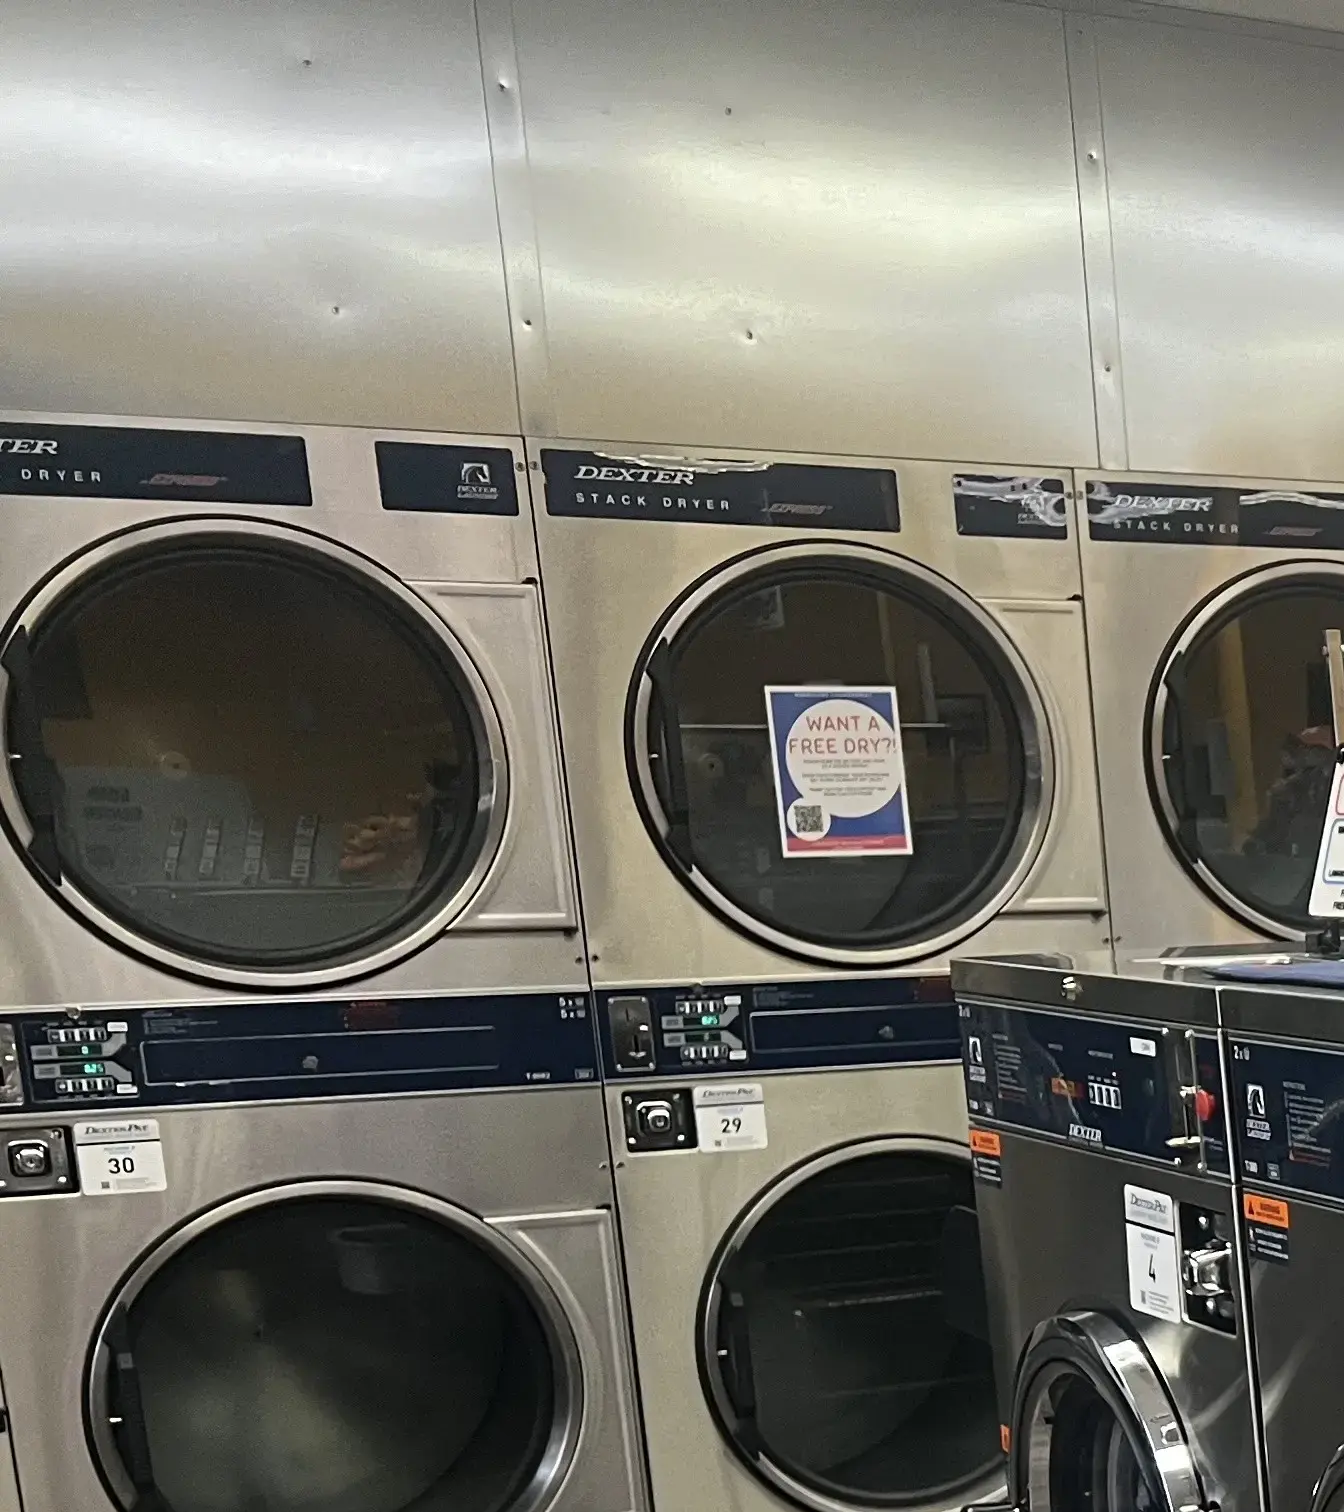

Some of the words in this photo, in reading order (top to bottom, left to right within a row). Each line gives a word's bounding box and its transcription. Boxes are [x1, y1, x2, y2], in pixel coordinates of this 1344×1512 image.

[22, 469, 100, 482] DRYER
[574, 466, 694, 485] DEXTER
[576, 492, 646, 507] STACK
[663, 497, 730, 510] DRYER
[806, 716, 860, 731] WANT
[868, 716, 880, 731] A
[789, 738, 838, 754] FREE
[721, 1118, 741, 1133] 29
[1069, 1123, 1102, 1142] DEXTER
[108, 1157, 134, 1174] 30
